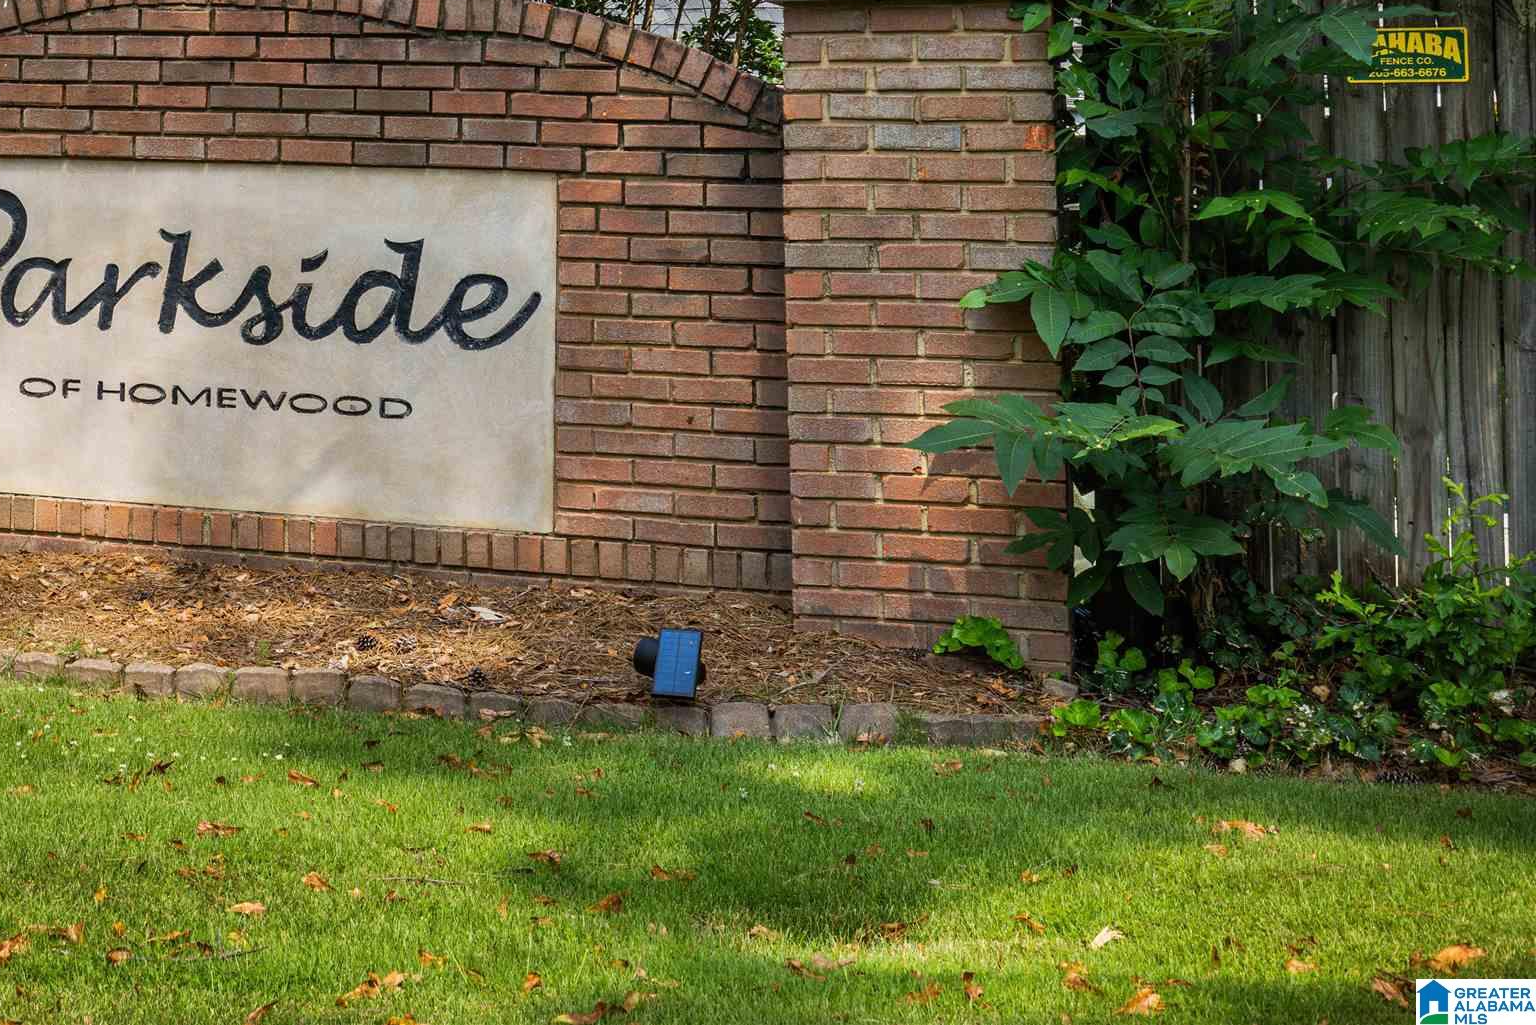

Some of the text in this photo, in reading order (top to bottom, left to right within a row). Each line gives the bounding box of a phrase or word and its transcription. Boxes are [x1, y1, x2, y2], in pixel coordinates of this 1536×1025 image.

[1371, 32, 1462, 65] AHABA
[1380, 57, 1434, 65] FENCE CO.
[19, 376, 413, 419] OF HOMEWOOD
